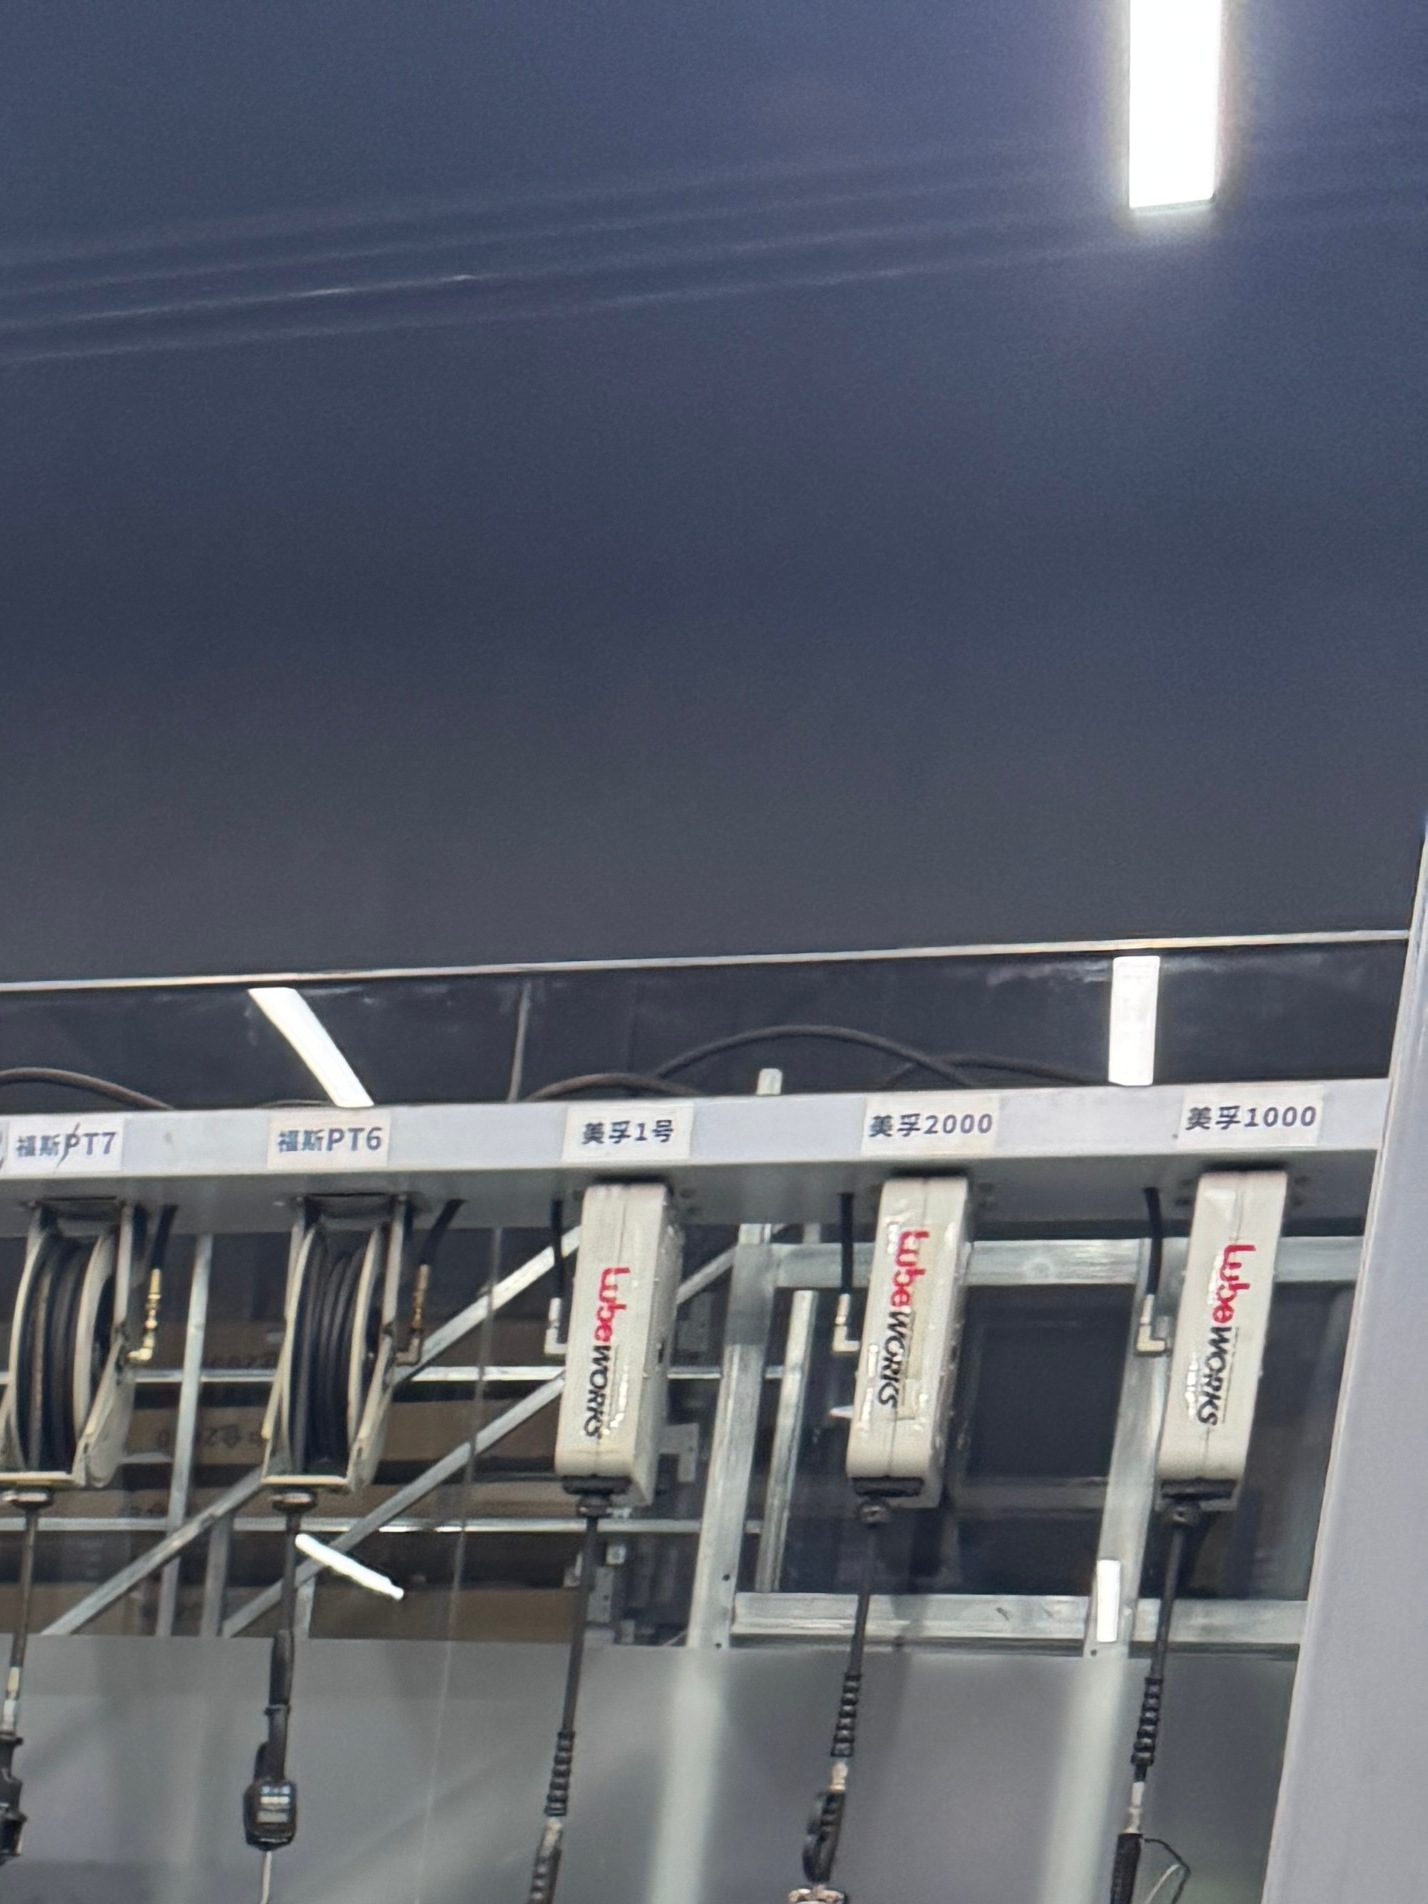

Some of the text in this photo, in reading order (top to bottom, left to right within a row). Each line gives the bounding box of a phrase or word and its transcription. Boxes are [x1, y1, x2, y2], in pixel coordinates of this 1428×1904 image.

[869, 1113, 993, 1138] 美孚2000
[1185, 1105, 1316, 1131] 美孚1000
[582, 1119, 674, 1145] 美孚1号
